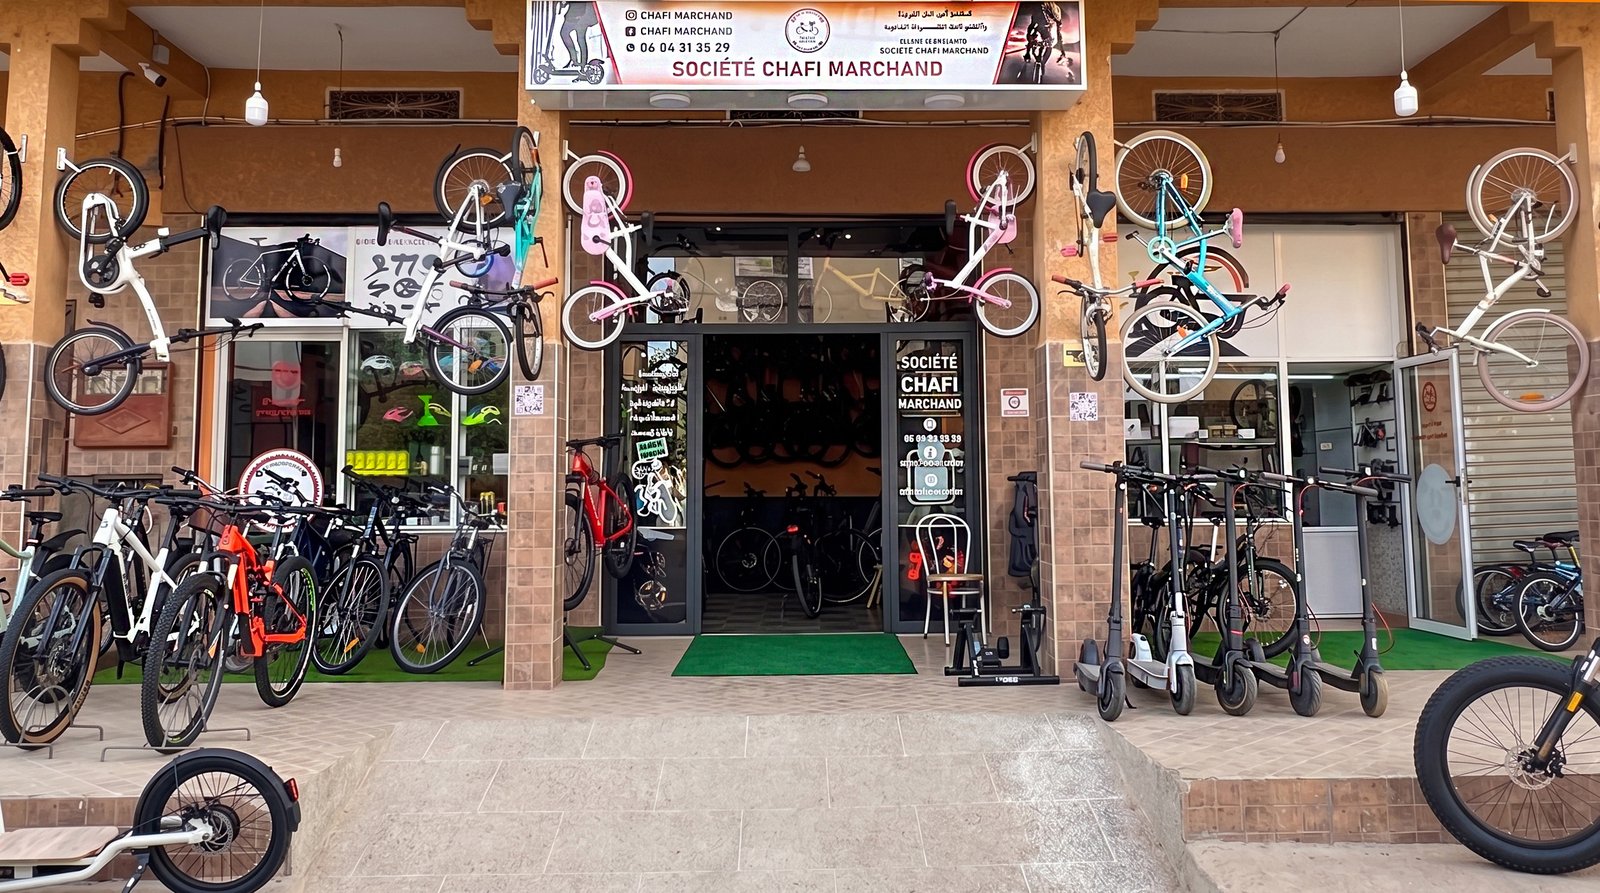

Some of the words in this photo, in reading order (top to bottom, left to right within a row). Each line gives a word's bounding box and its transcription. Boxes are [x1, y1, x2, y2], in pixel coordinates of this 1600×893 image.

[640, 11, 671, 20] CHAFI
[674, 11, 733, 20] MARCHAND
[640, 27, 671, 36] CHAFI
[674, 27, 733, 36] MARCHAND
[640, 42, 655, 53] 06
[660, 42, 675, 53] 04
[679, 42, 692, 53] 31
[696, 42, 711, 53] 35
[715, 42, 730, 53] 29
[672, 57, 755, 77] SOCIÉTÉ
[762, 61, 821, 77] CHAFI
[829, 61, 943, 77] MARCHAND
[901, 353, 958, 369] SOCIÉTÉ
[901, 376, 958, 393] CHAFI
[898, 398, 962, 409] MARCHAND
